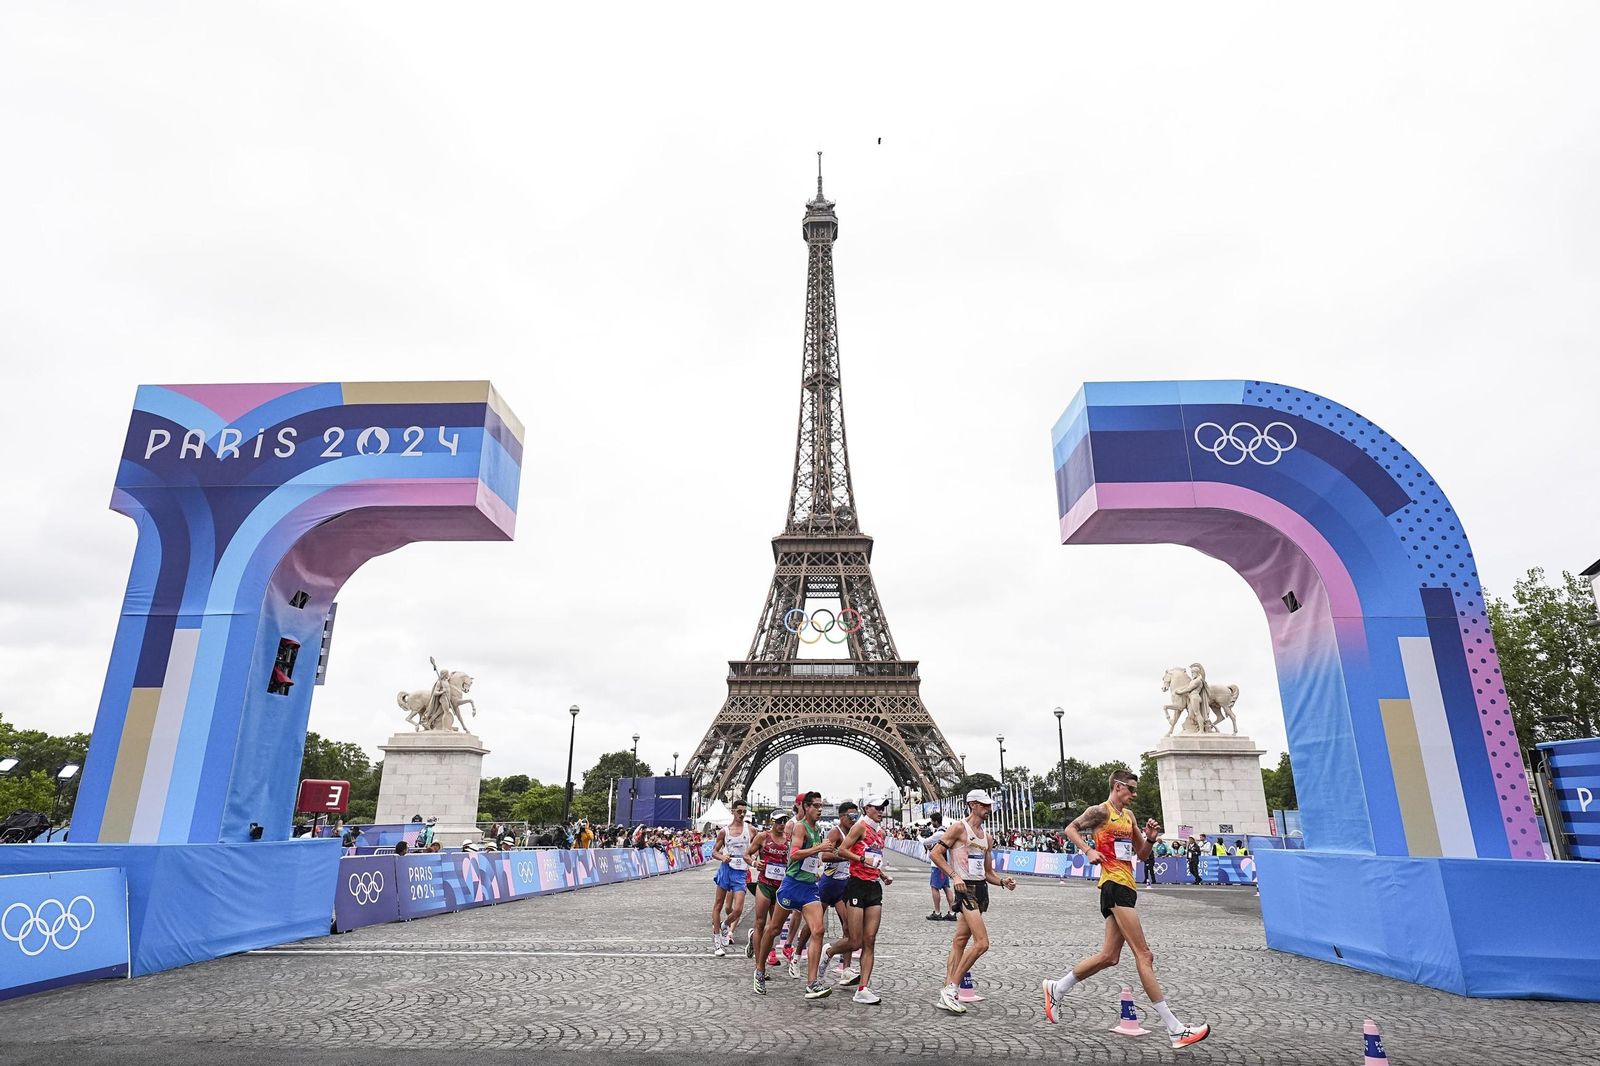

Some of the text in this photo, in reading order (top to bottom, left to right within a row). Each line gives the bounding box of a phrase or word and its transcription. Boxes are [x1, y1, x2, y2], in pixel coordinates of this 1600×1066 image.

[319, 425, 460, 457] 2024
[325, 785, 342, 806] 3
[1576, 787, 1593, 812] P
[1186, 868, 1209, 876] 224
[410, 883, 435, 901] 2024
